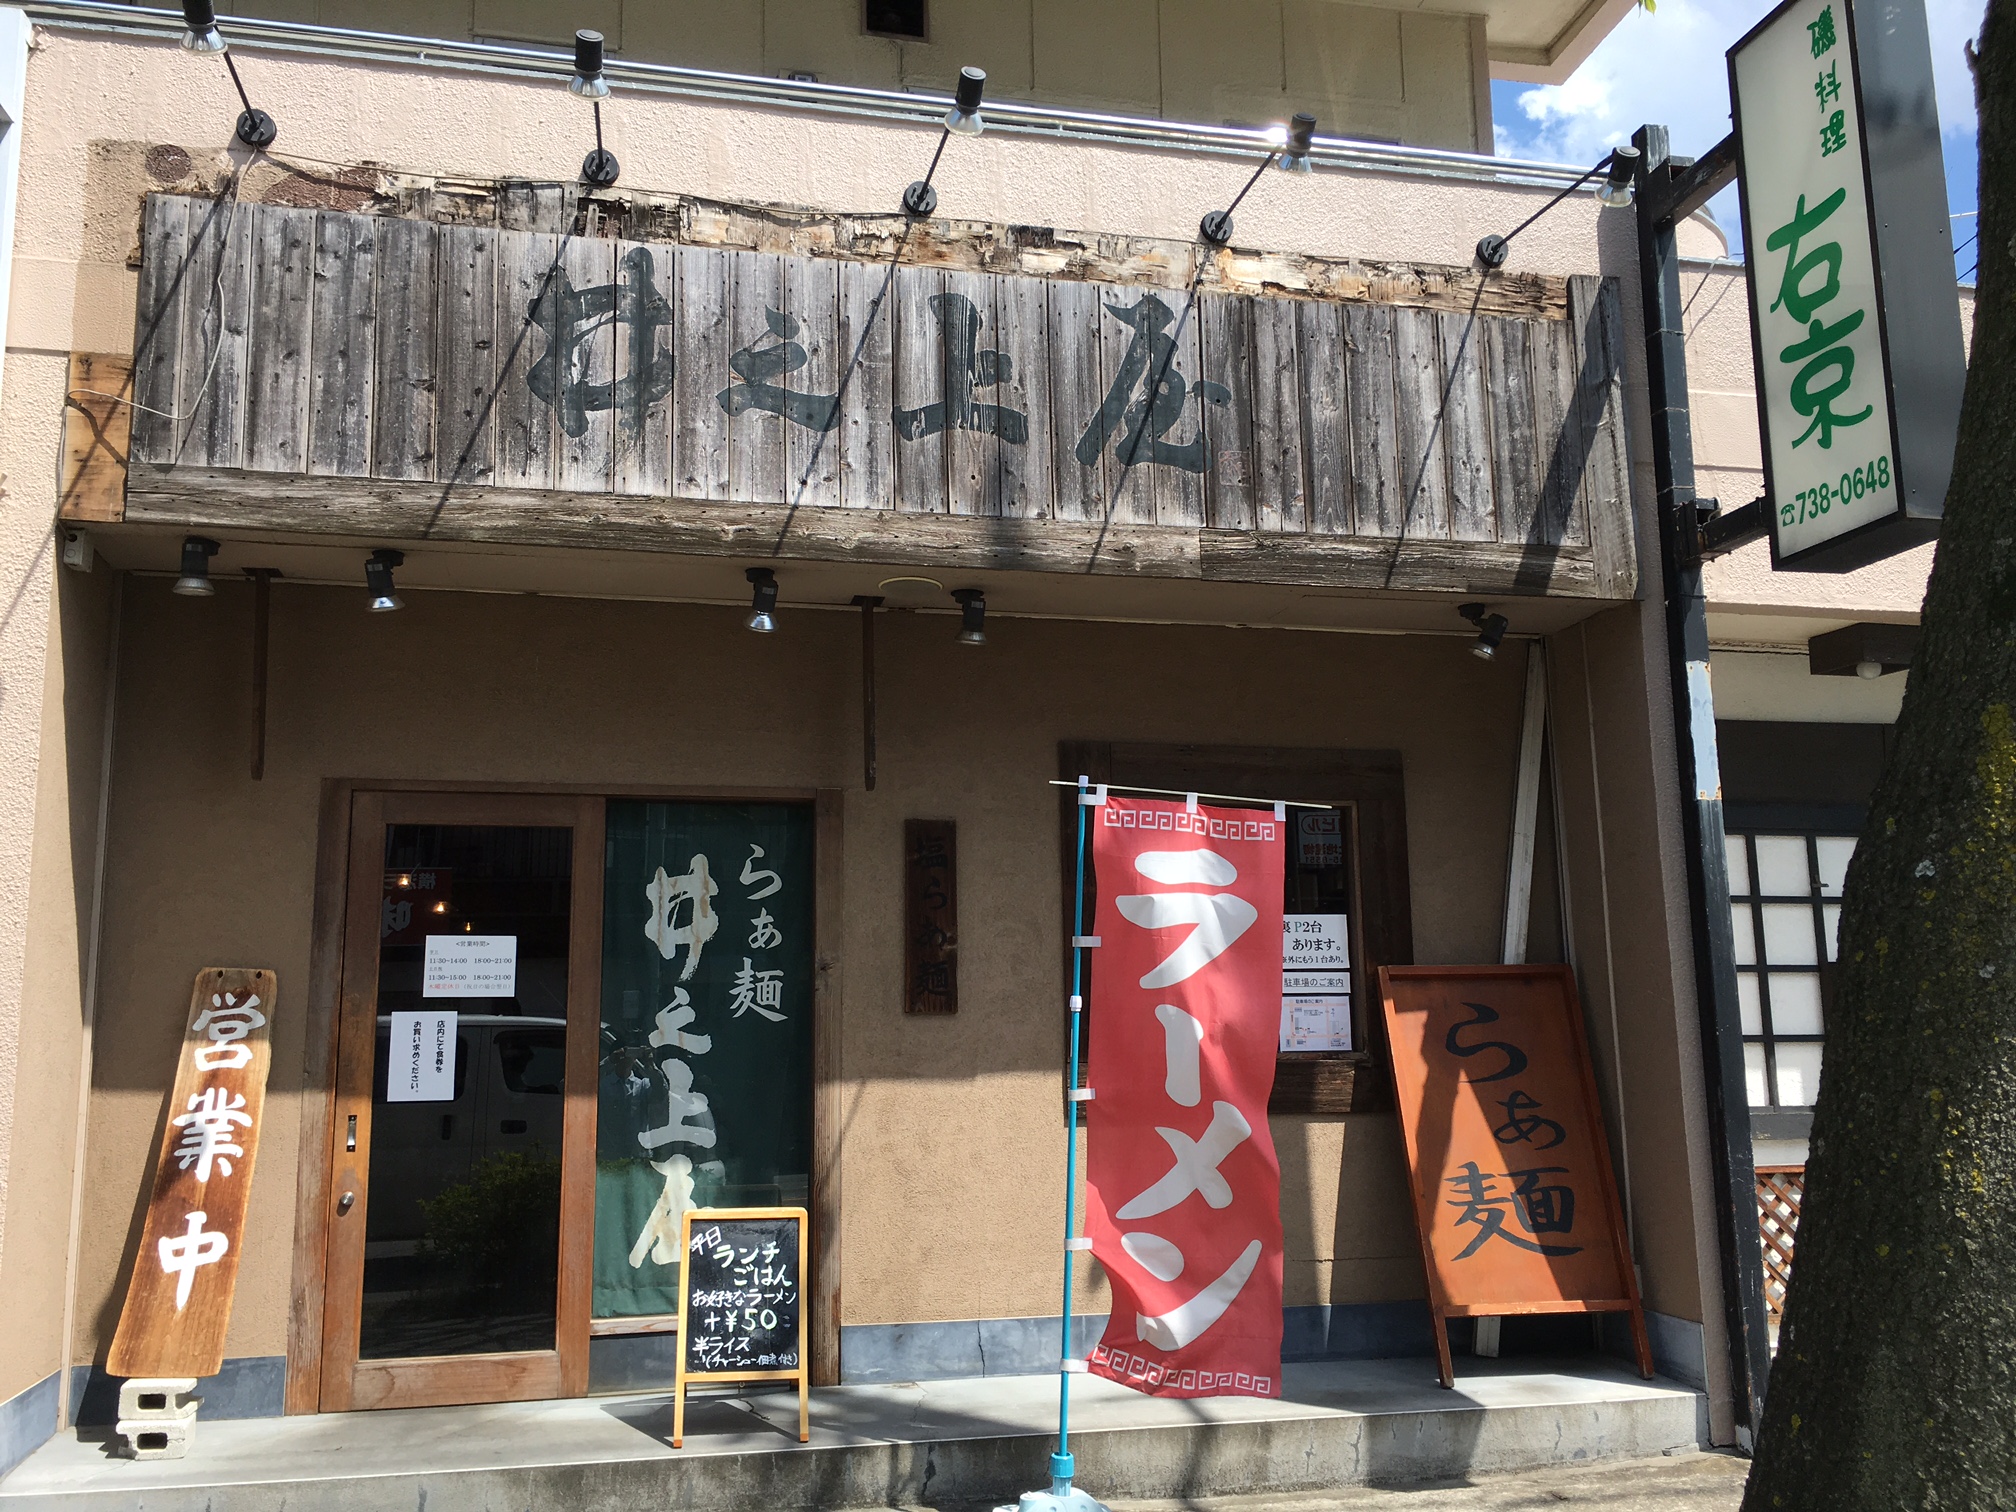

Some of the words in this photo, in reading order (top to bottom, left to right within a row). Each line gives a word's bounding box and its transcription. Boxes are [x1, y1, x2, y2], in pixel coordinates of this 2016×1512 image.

[1807, 4, 1848, 158] 磯料理
[1766, 187, 1873, 450] 右京
[1795, 455, 1890, 525] 738-0648
[729, 844, 788, 1022] らぁ麺
[1292, 938, 1341, 951] あります。
[1284, 978, 1344, 987] 駐車場のご案内
[1115, 848, 1262, 1352] ラーメン
[1444, 1002, 1584, 1262] らぁ麺
[158, 993, 267, 1310] 営業中
[713, 1241, 780, 1268] ランチ
[734, 1264, 793, 1287] ごはん
[692, 1288, 797, 1308] お好きなラーメン
[692, 1336, 750, 1356] 半ライス
